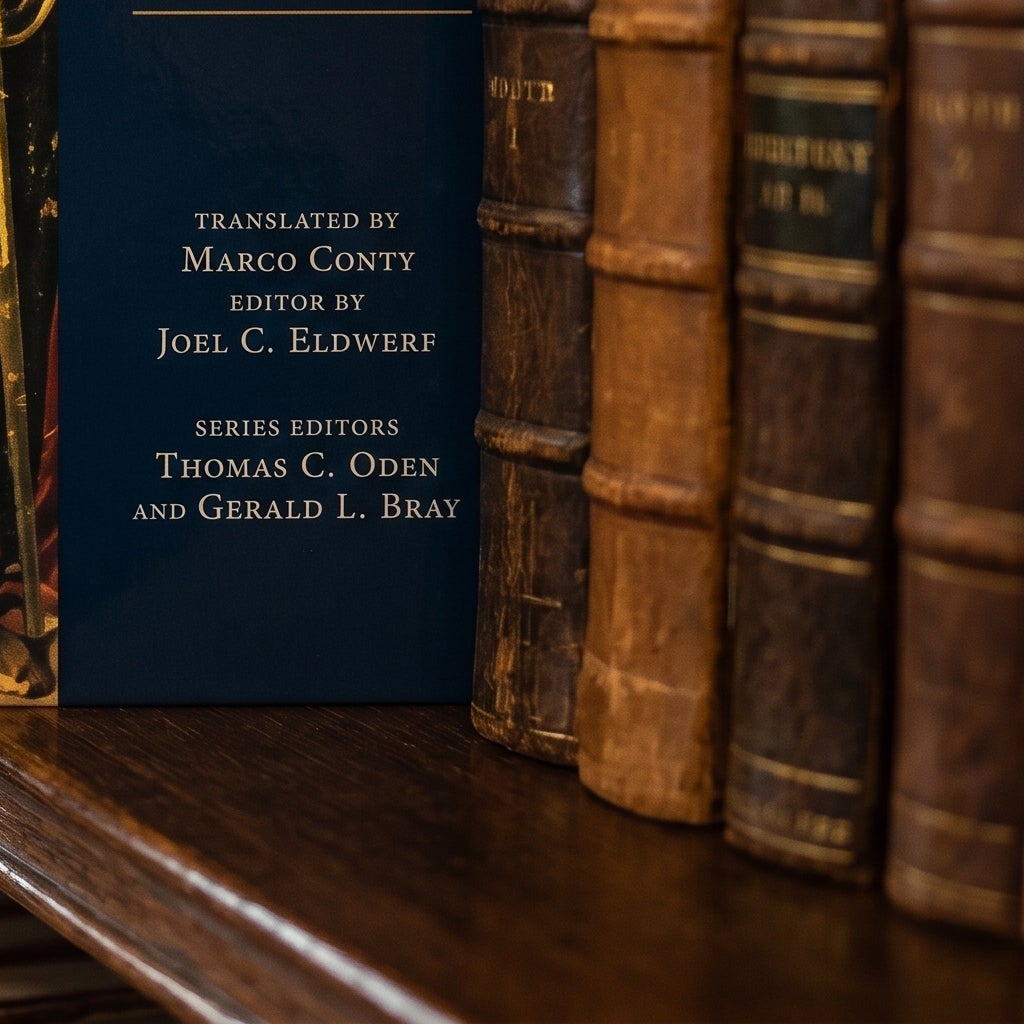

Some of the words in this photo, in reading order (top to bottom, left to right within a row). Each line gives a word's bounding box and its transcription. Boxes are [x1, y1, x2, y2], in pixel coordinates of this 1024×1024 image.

[194, 212, 359, 230] TRANSLATED
[369, 212, 400, 229] BY
[181, 246, 297, 272] MARCO
[309, 245, 416, 272] CONTY
[229, 294, 326, 312] EDITOR
[334, 294, 365, 311] BY
[156, 327, 229, 360] JOEL
[241, 326, 274, 354] C.
[289, 327, 436, 353] ELDWERF
[195, 419, 280, 437] SERIES
[290, 418, 399, 436] EDITORS
[155, 451, 287, 479] THOMAS
[301, 451, 334, 478] C.
[349, 451, 440, 478] ODEN
[132, 503, 186, 520] AND
[198, 493, 323, 520] GERALD
[336, 493, 366, 519] L.
[380, 493, 461, 519] BRAY
